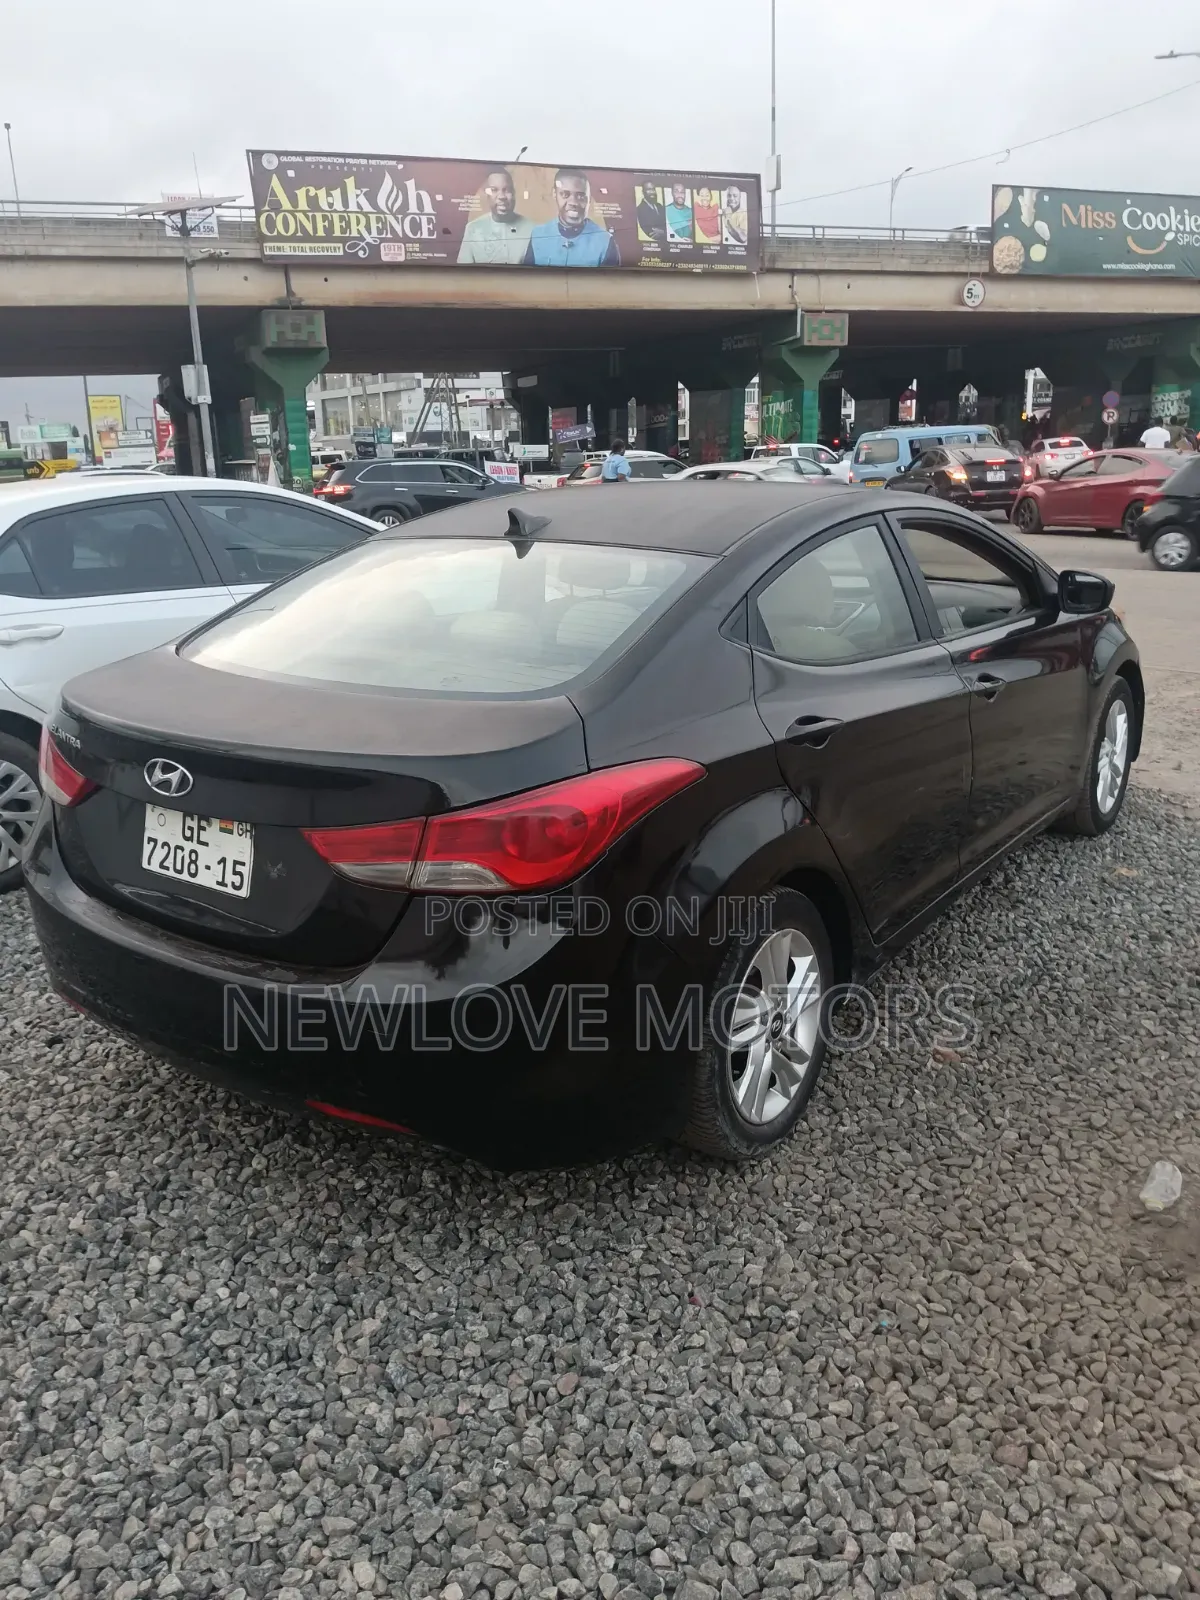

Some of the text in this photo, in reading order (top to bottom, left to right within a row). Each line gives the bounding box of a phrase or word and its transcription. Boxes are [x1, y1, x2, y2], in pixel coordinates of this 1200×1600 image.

[305, 156, 344, 164] RESTORATION
[259, 211, 437, 240] CONFERENCE
[1061, 203, 1200, 233] Miss Cookie
[264, 245, 341, 254] THEME: TOTAL RECOVERY
[51, 723, 81, 750] ELANTRA
[181, 813, 252, 848] GE GH
